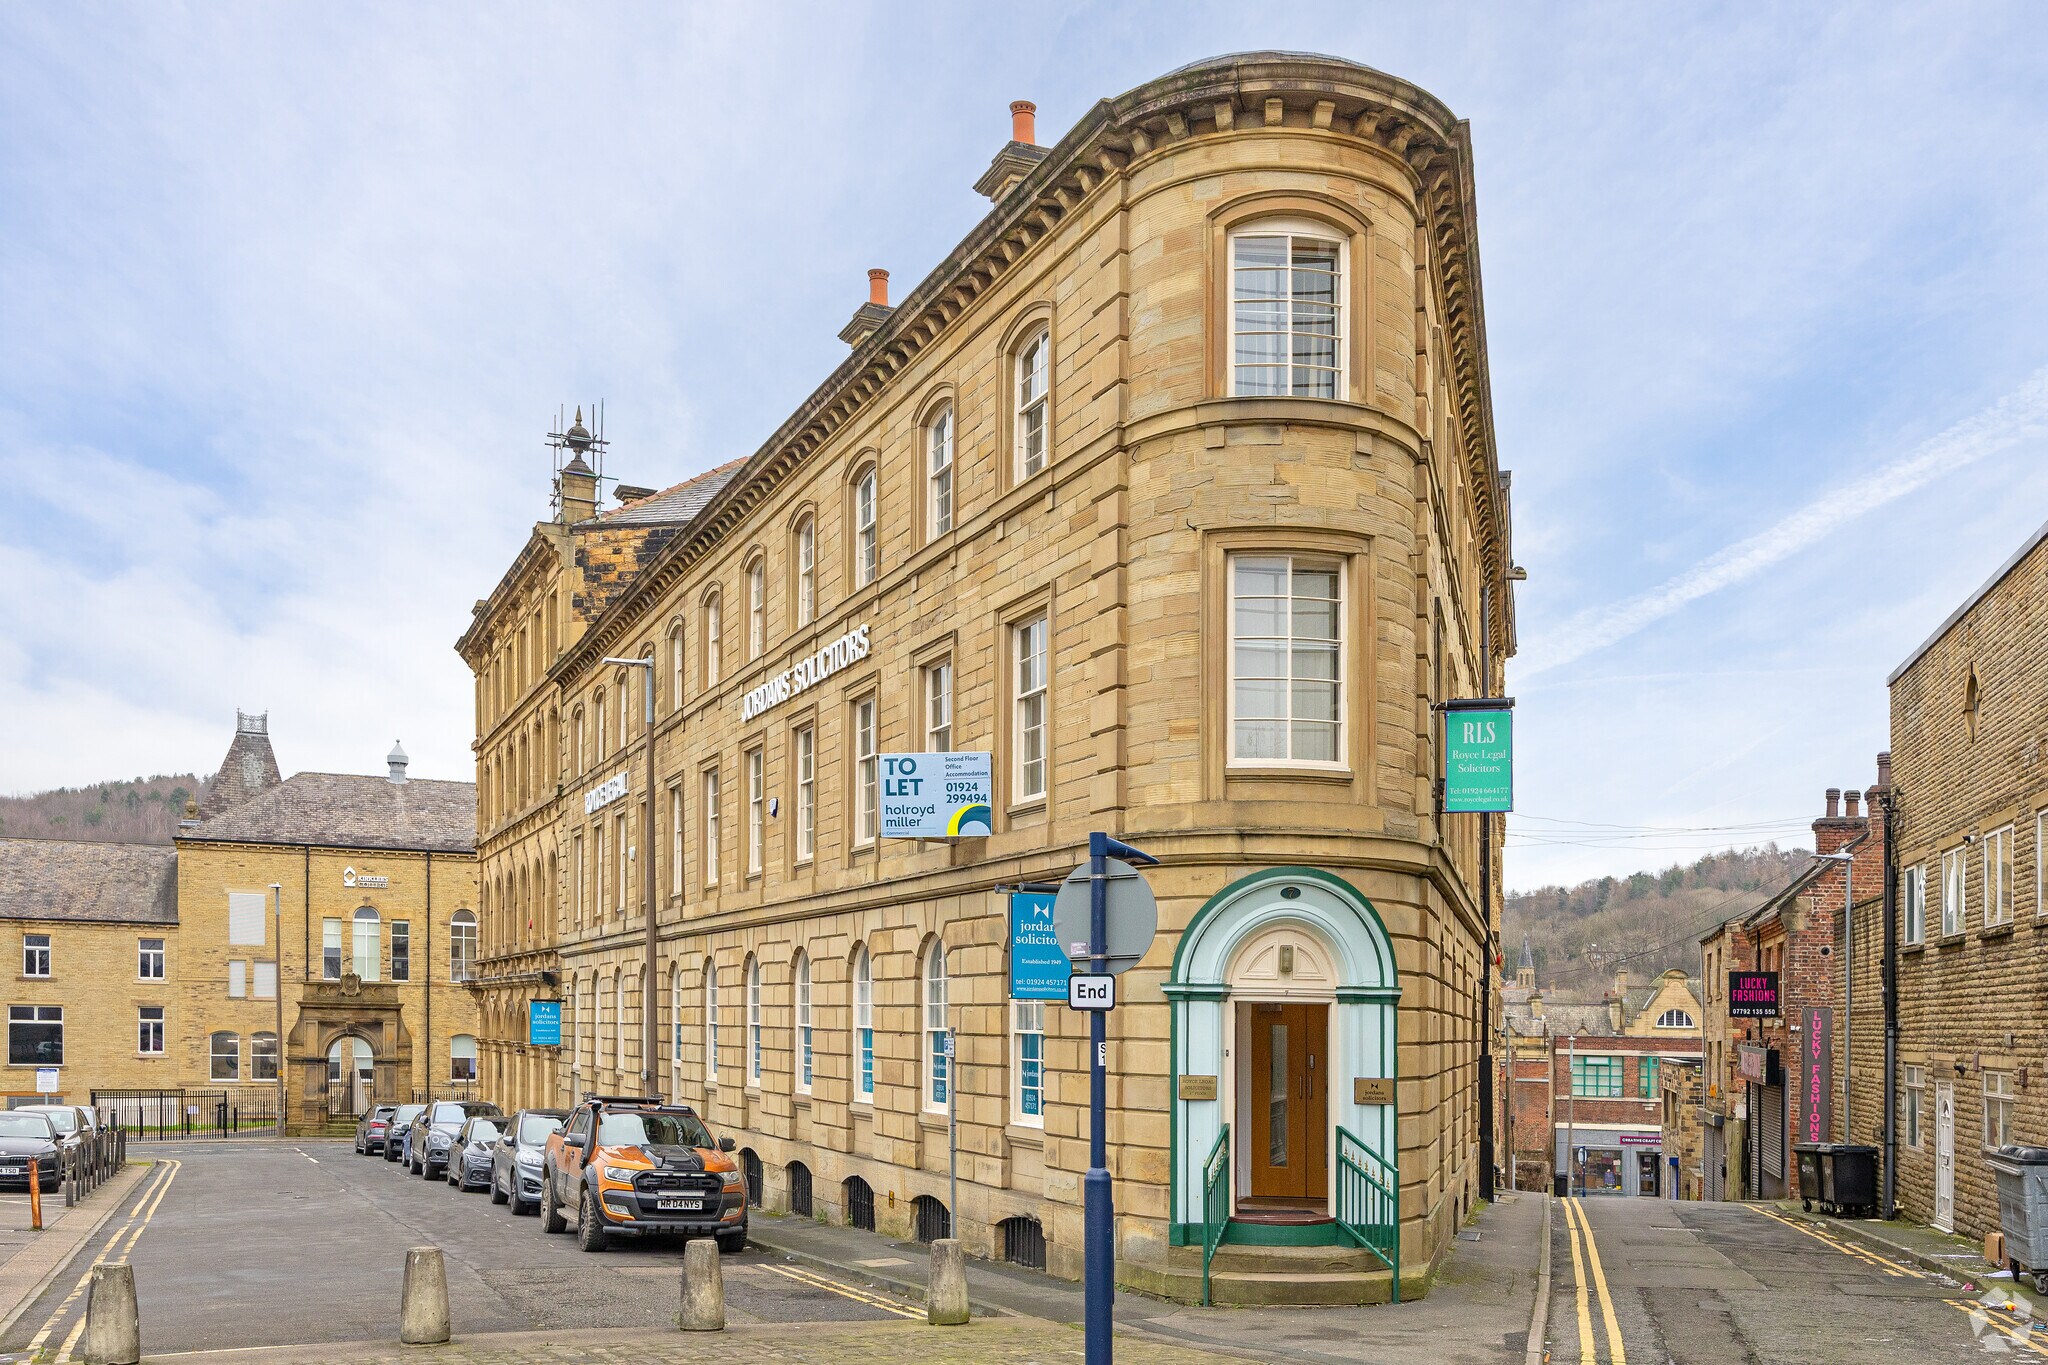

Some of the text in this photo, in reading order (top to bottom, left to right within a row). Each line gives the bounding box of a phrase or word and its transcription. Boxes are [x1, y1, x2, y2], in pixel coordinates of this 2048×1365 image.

[742, 624, 870, 722] JORDANS SOLICITORS
[1463, 722, 1496, 744] RLS
[1452, 750, 1506, 762] Royce Legal
[884, 758, 916, 775] TO
[1458, 764, 1500, 773] Solicitors
[885, 779, 923, 796] LET
[946, 782, 978, 792] 01924
[946, 794, 988, 803] 299494
[886, 804, 935, 817] holroyd
[886, 817, 922, 827] miller
[1288, 889, 1294, 898] 7
[1021, 920, 1054, 934] jordan
[1016, 934, 1059, 945] solicito
[1740, 978, 1768, 989] LUCKY
[1077, 984, 1107, 999] End
[1732, 990, 1776, 1002] FASHIONS
[1810, 1011, 1822, 1142] LUCKY FASHIONS
[644, 1178, 713, 1187] FORD
